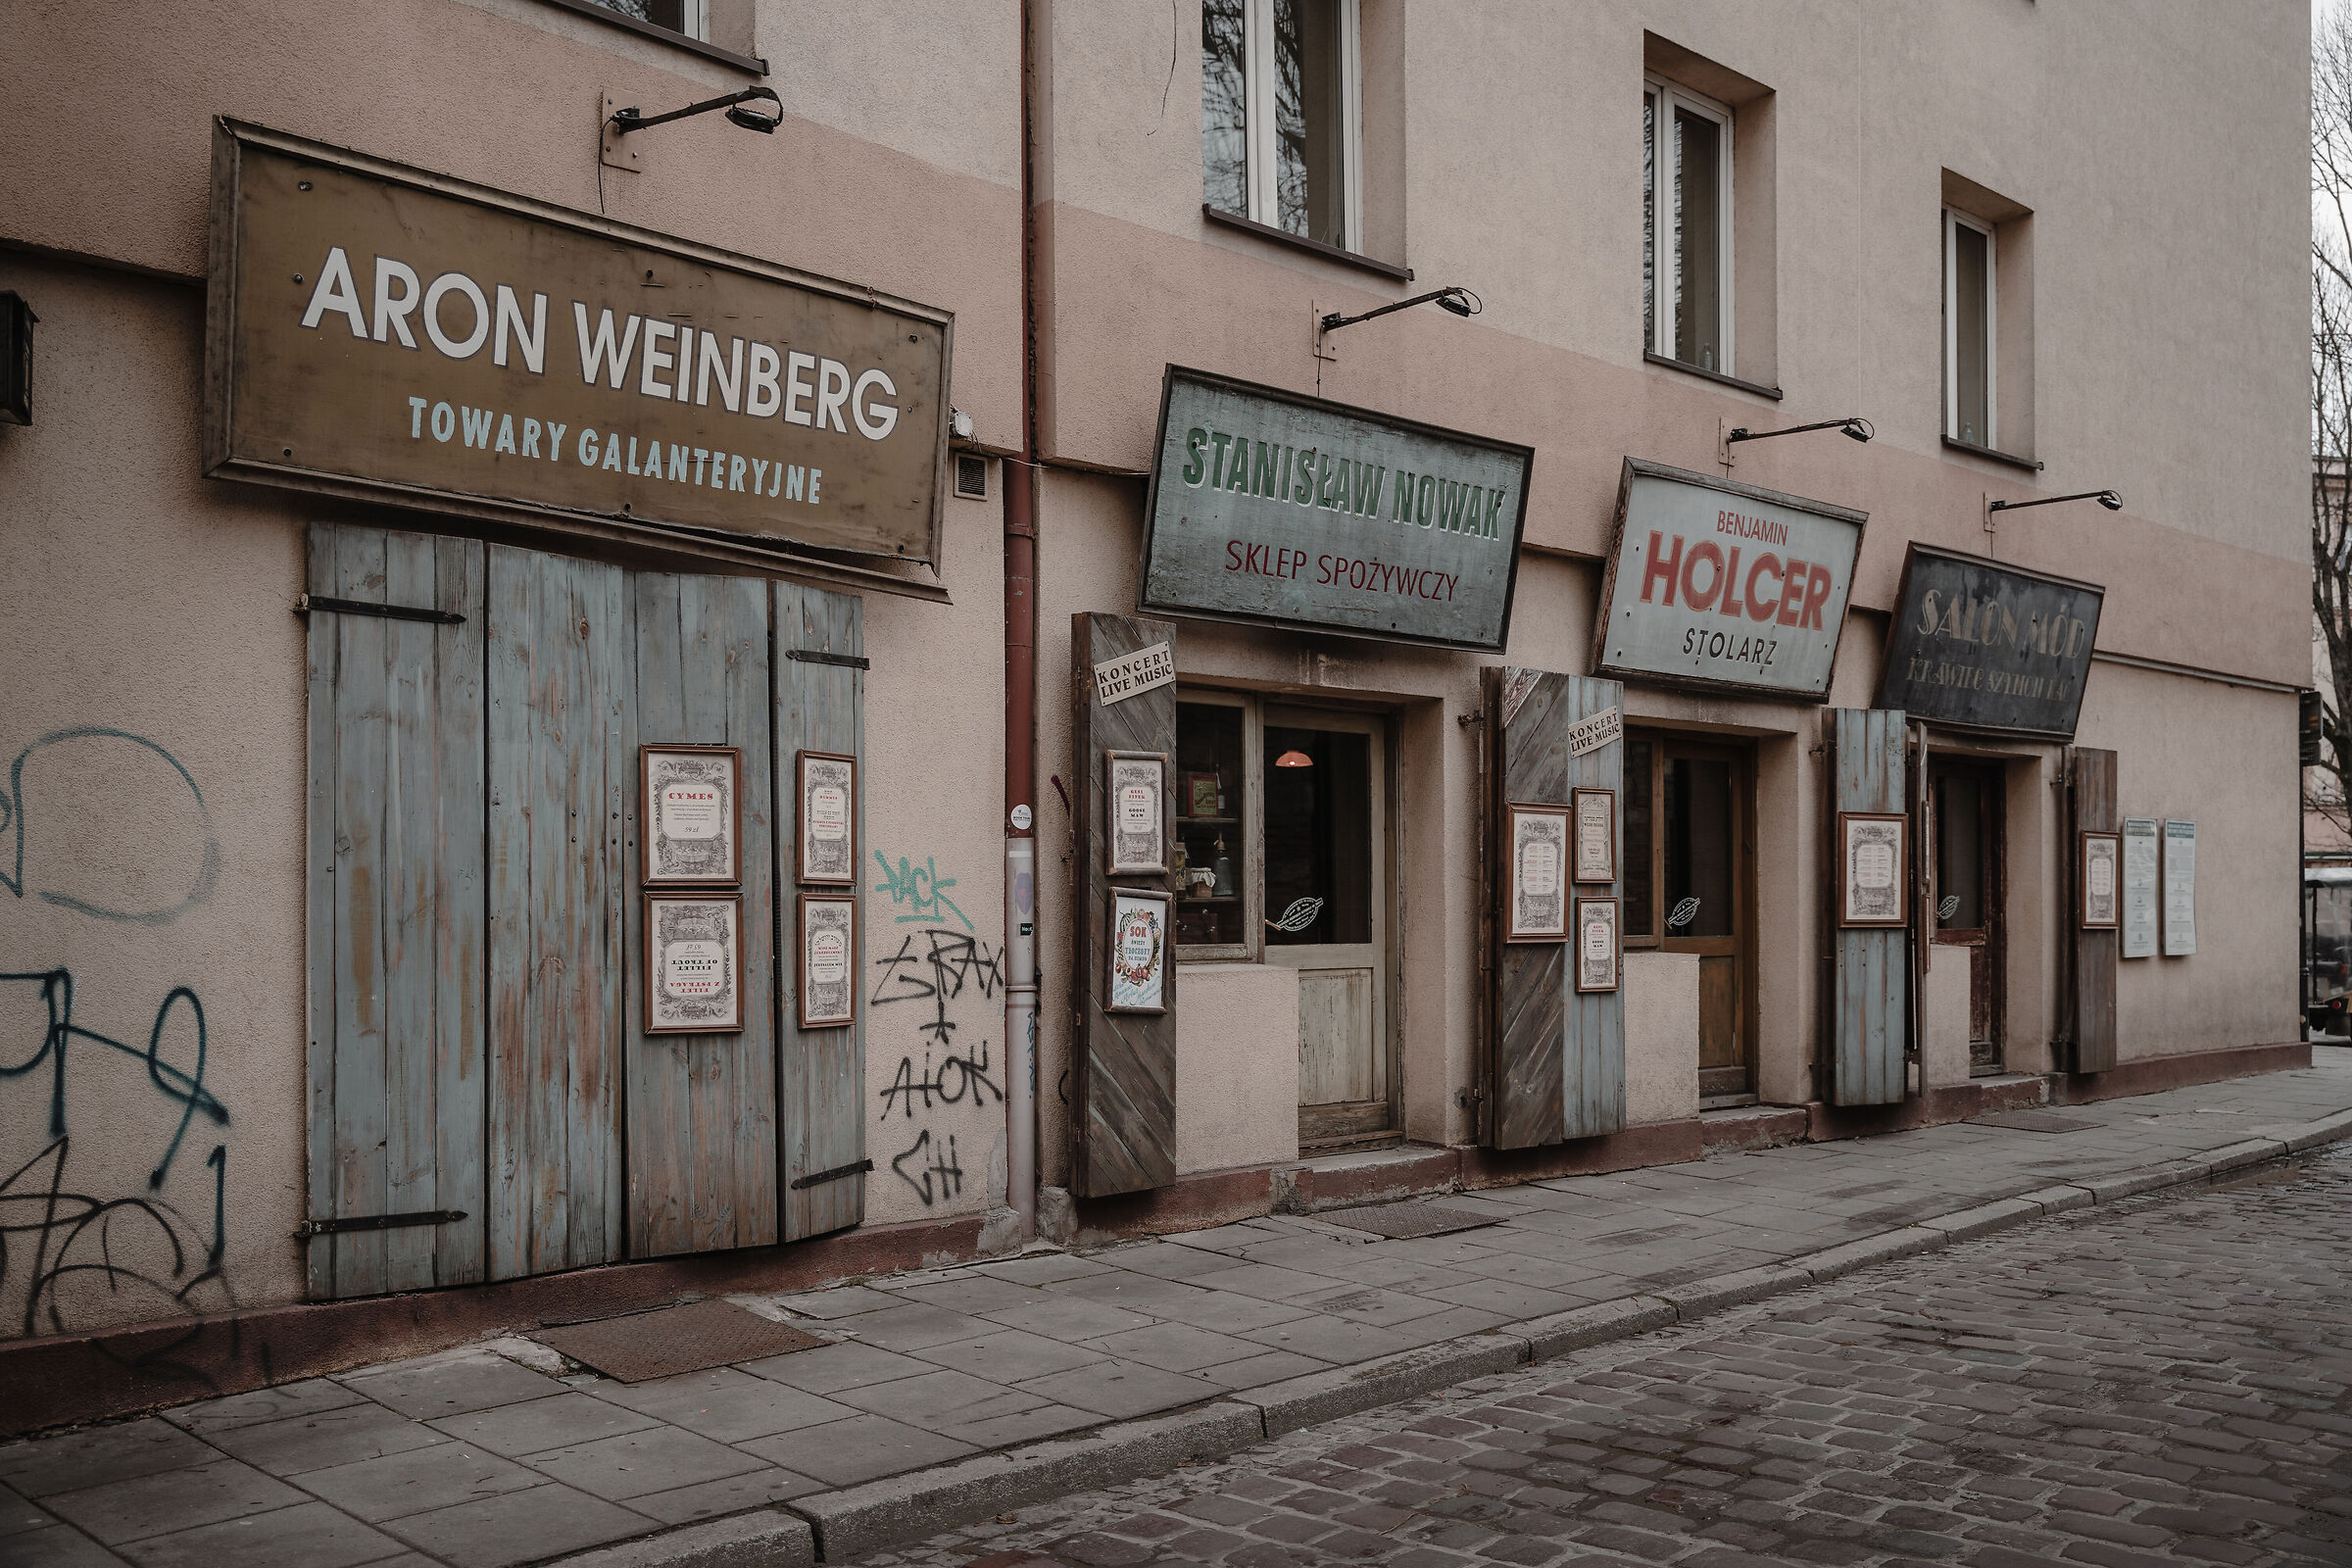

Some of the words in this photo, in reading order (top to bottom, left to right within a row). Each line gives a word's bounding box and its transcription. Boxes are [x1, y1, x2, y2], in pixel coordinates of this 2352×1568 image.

[301, 246, 548, 374] ARON
[572, 302, 899, 441] WEINBERG
[409, 396, 567, 463] TOWARY
[578, 427, 822, 506] GALANTERYJNE
[1183, 427, 1386, 519] STANISŁAW
[1393, 469, 1506, 541] NOWAK
[1716, 509, 1788, 547] BENJAMIN
[1225, 539, 1307, 580] SKLEP
[1316, 555, 1459, 602] SPOŻYWCZY
[1640, 529, 1833, 631] HOLCER
[1916, 588, 2021, 651] SALON
[2025, 603, 2086, 660] MÓD
[1682, 627, 1778, 666] STOLARZ
[1098, 650, 1169, 685] KONCERT
[1101, 678, 1131, 699] LIVE
[1134, 662, 1173, 688] MUSIC
[1568, 712, 1619, 742] KONCERT
[1570, 734, 1594, 753] LIVE
[1594, 723, 1621, 745] MUSIC
[667, 792, 714, 801] CYMES
[1130, 925, 1147, 937] SOK
